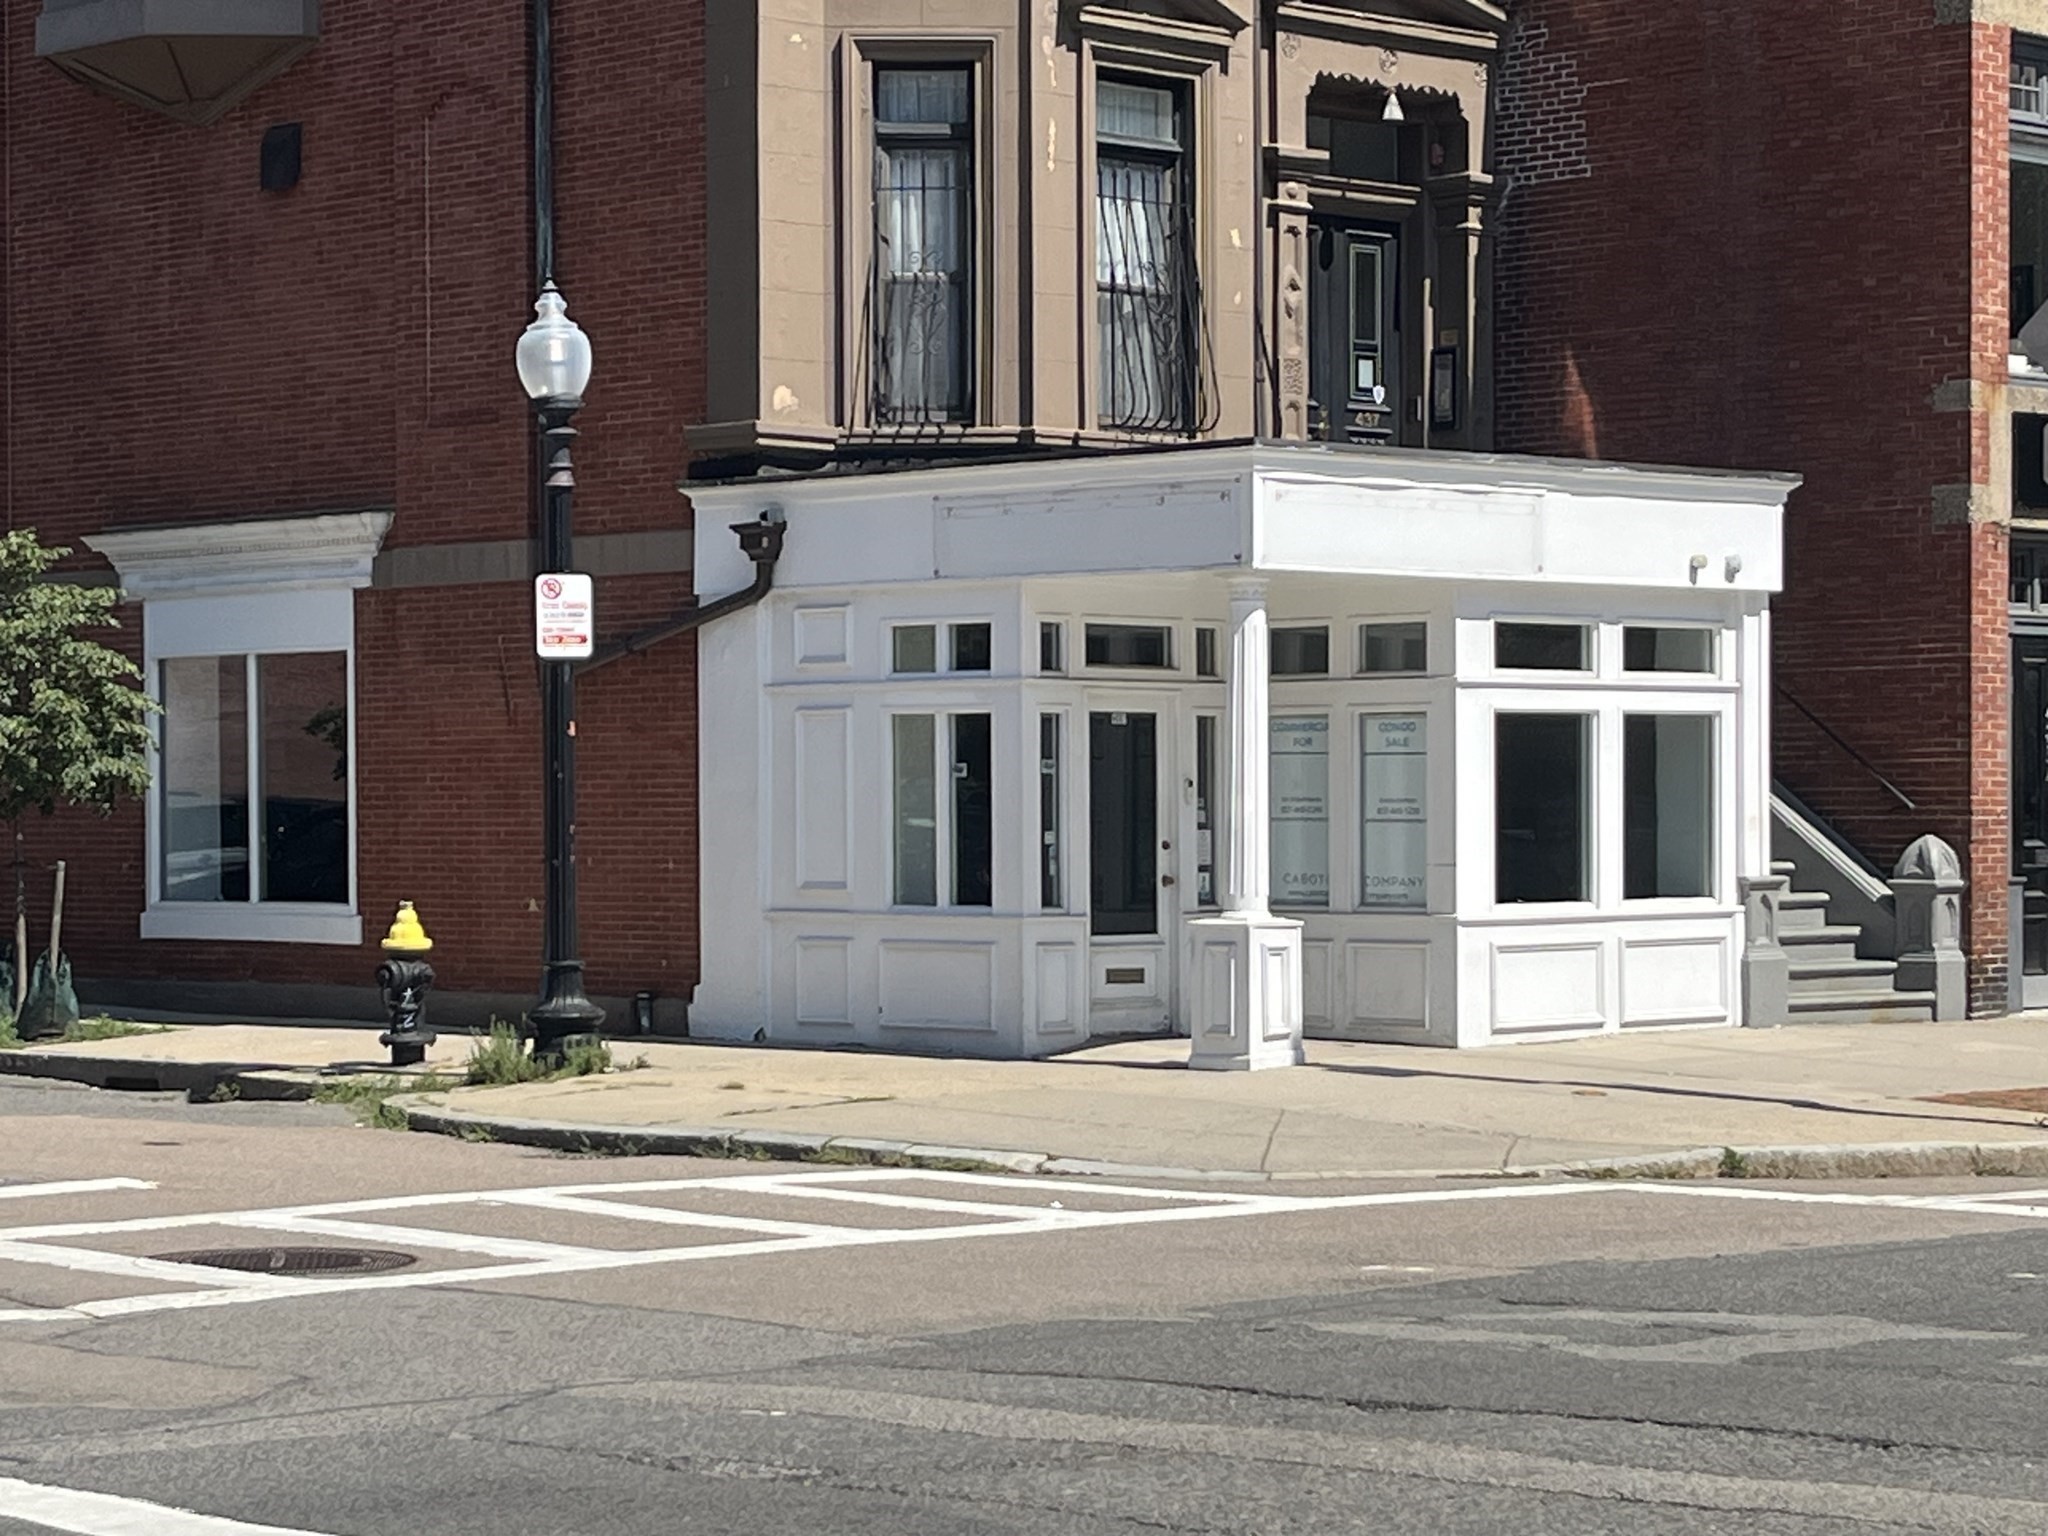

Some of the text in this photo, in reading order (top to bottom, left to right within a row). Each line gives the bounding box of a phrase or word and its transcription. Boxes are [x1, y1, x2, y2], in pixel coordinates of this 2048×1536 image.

[1292, 736, 1409, 748] FOR SALE
[1282, 872, 1325, 886] CABOT
